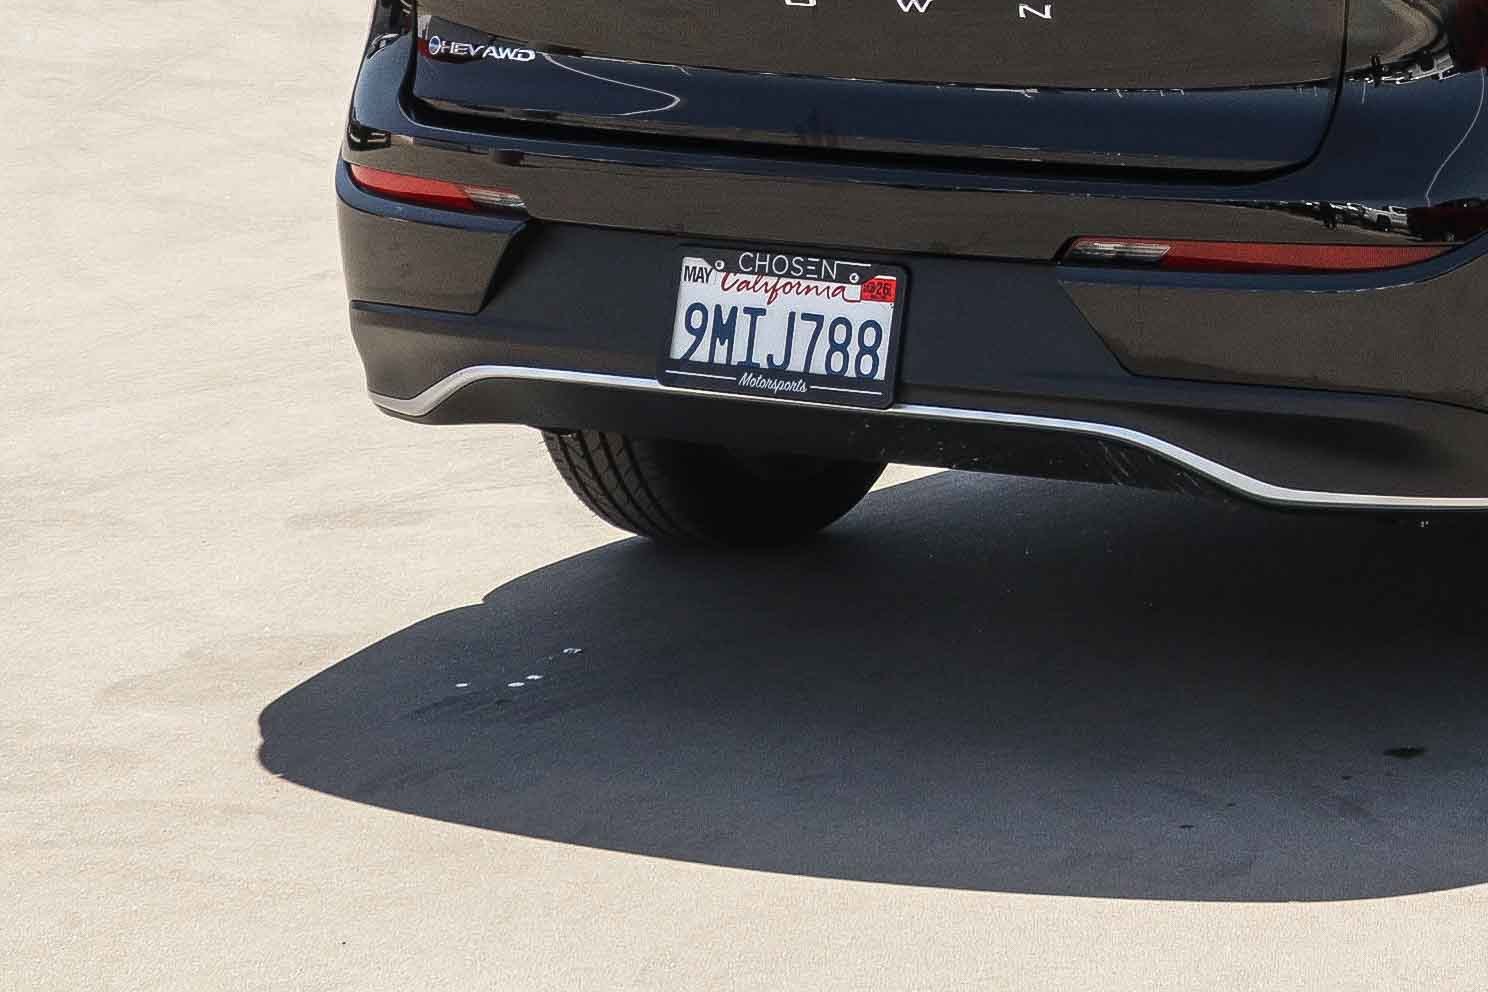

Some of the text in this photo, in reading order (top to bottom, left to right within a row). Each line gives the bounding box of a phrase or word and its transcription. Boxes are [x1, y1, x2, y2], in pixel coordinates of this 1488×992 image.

[683, 265, 713, 283] MAY
[738, 252, 837, 280] CHOSEN
[720, 272, 862, 305] California
[682, 302, 883, 379] 9MIJ788
[738, 372, 808, 394] Motorsports
